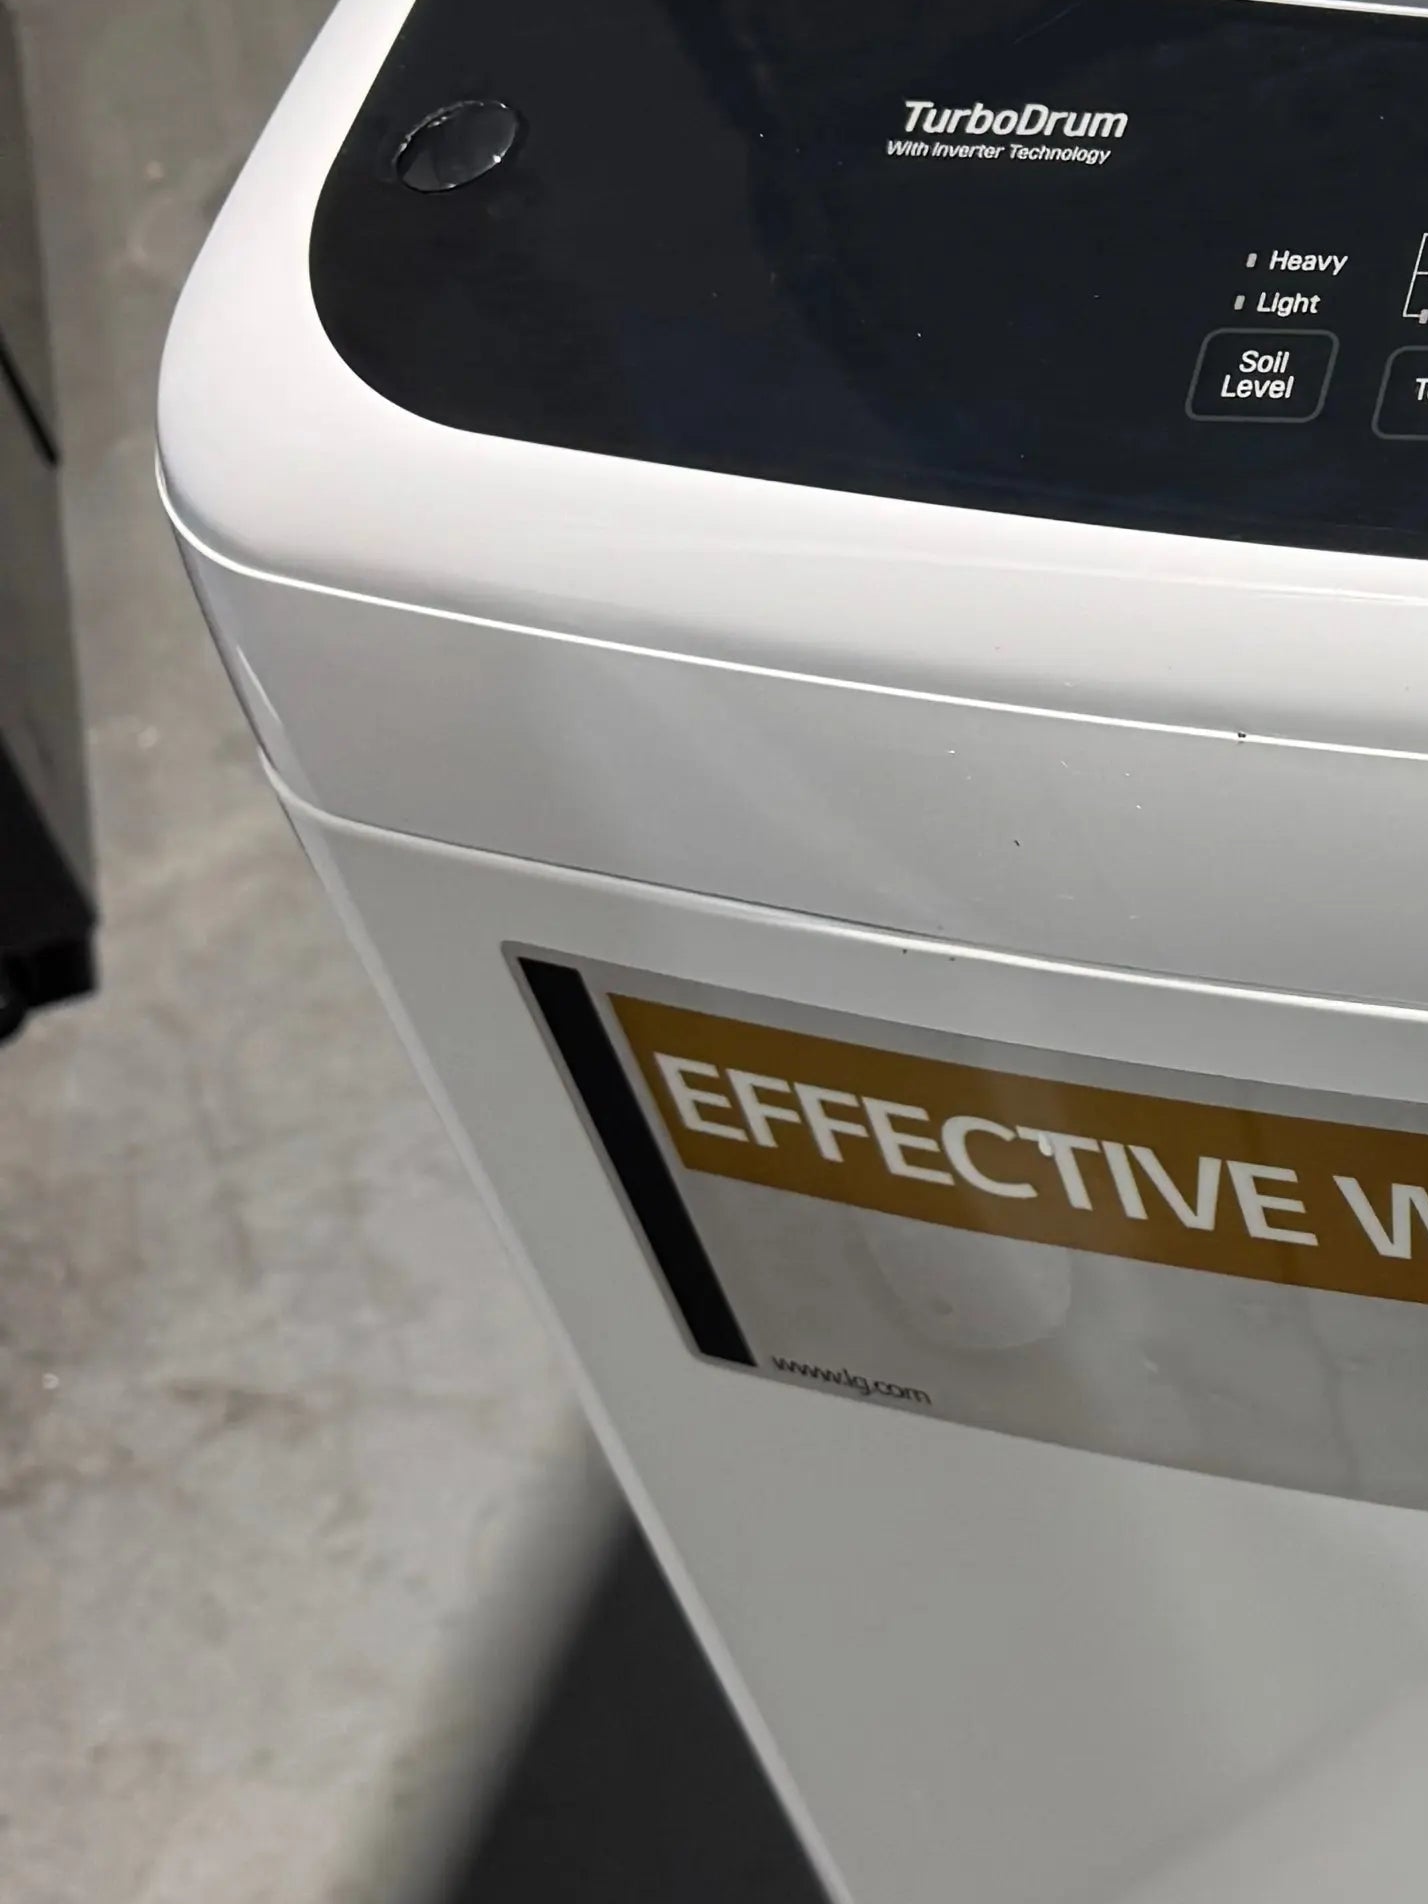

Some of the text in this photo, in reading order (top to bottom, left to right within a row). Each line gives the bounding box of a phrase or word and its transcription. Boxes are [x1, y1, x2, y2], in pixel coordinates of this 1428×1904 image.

[903, 99, 1129, 139] TurboDrum
[886, 140, 1112, 165] With Inverter Technology
[1268, 249, 1348, 276] Heavy
[1255, 292, 1321, 317] Light
[1238, 350, 1290, 374] Soil
[1220, 374, 1295, 399] Level
[653, 1050, 1318, 1248] EFFECTIVE
[770, 1351, 932, 1407] www.lg.com
